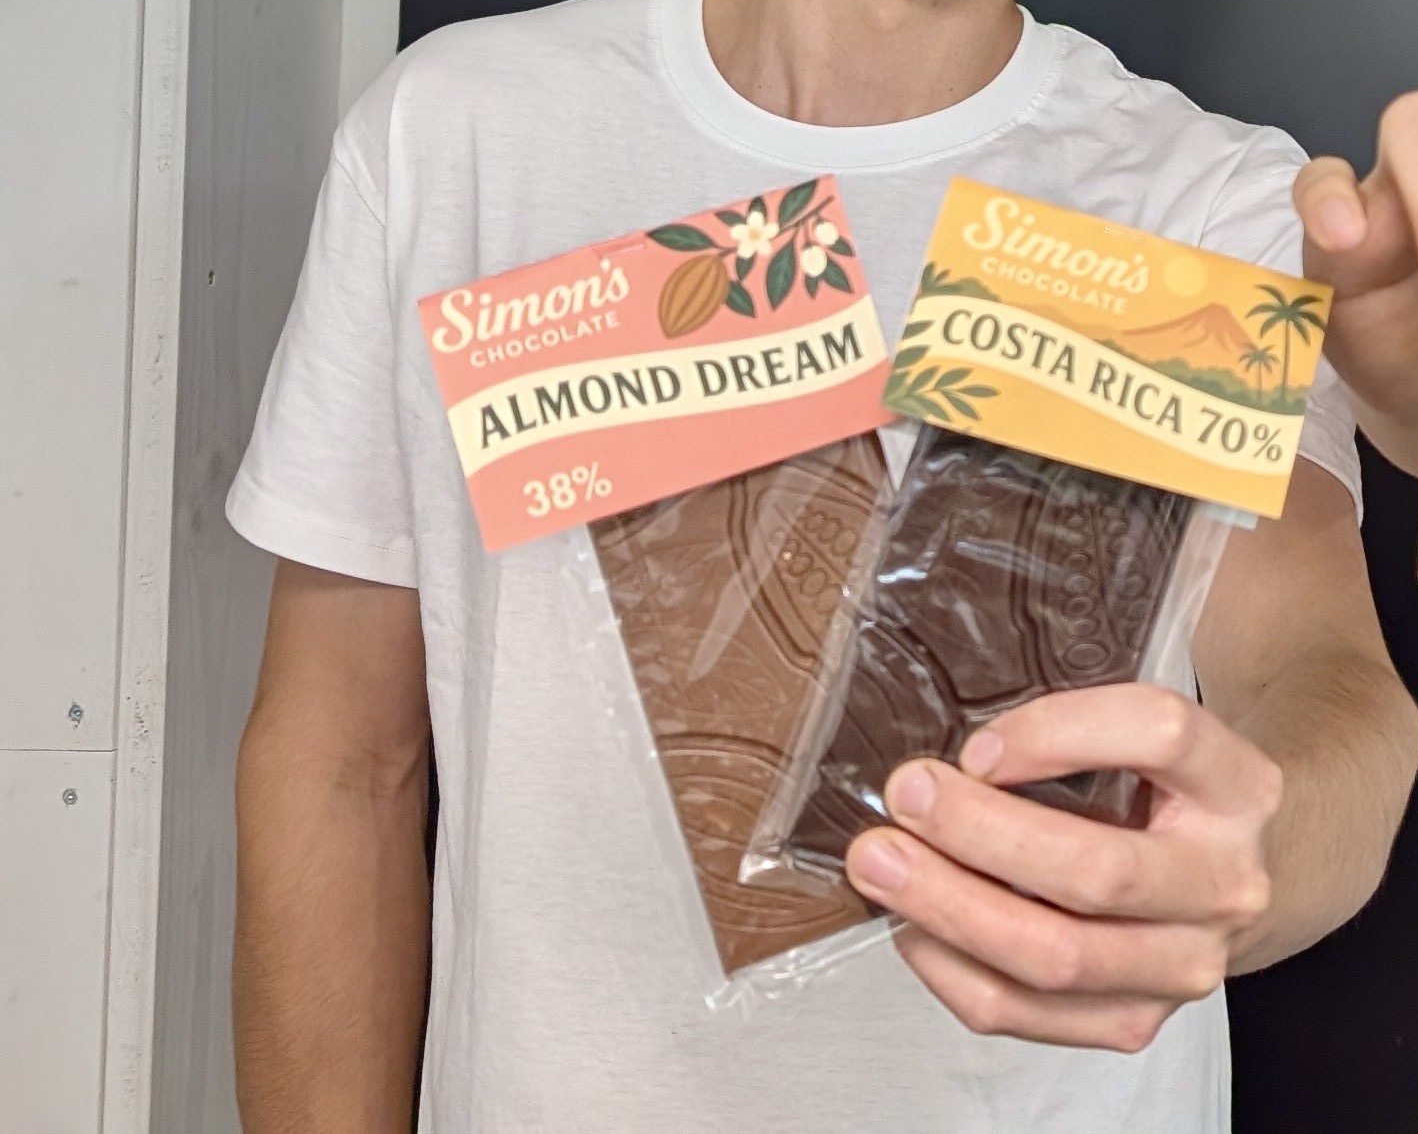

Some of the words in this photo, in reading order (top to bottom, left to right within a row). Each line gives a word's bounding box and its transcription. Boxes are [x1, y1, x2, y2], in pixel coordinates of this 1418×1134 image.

[962, 197, 1151, 296] Simon's
[980, 256, 1130, 316] CHOCOLATE
[431, 258, 630, 353] Simon's
[469, 310, 622, 368] CHOCOLATE
[479, 364, 683, 450] ALMOND
[695, 322, 865, 398] DREAM
[942, 308, 1077, 384] COSTA
[1089, 360, 1184, 435] RICA
[1197, 407, 1286, 465] 70%
[522, 462, 613, 518] 38%
